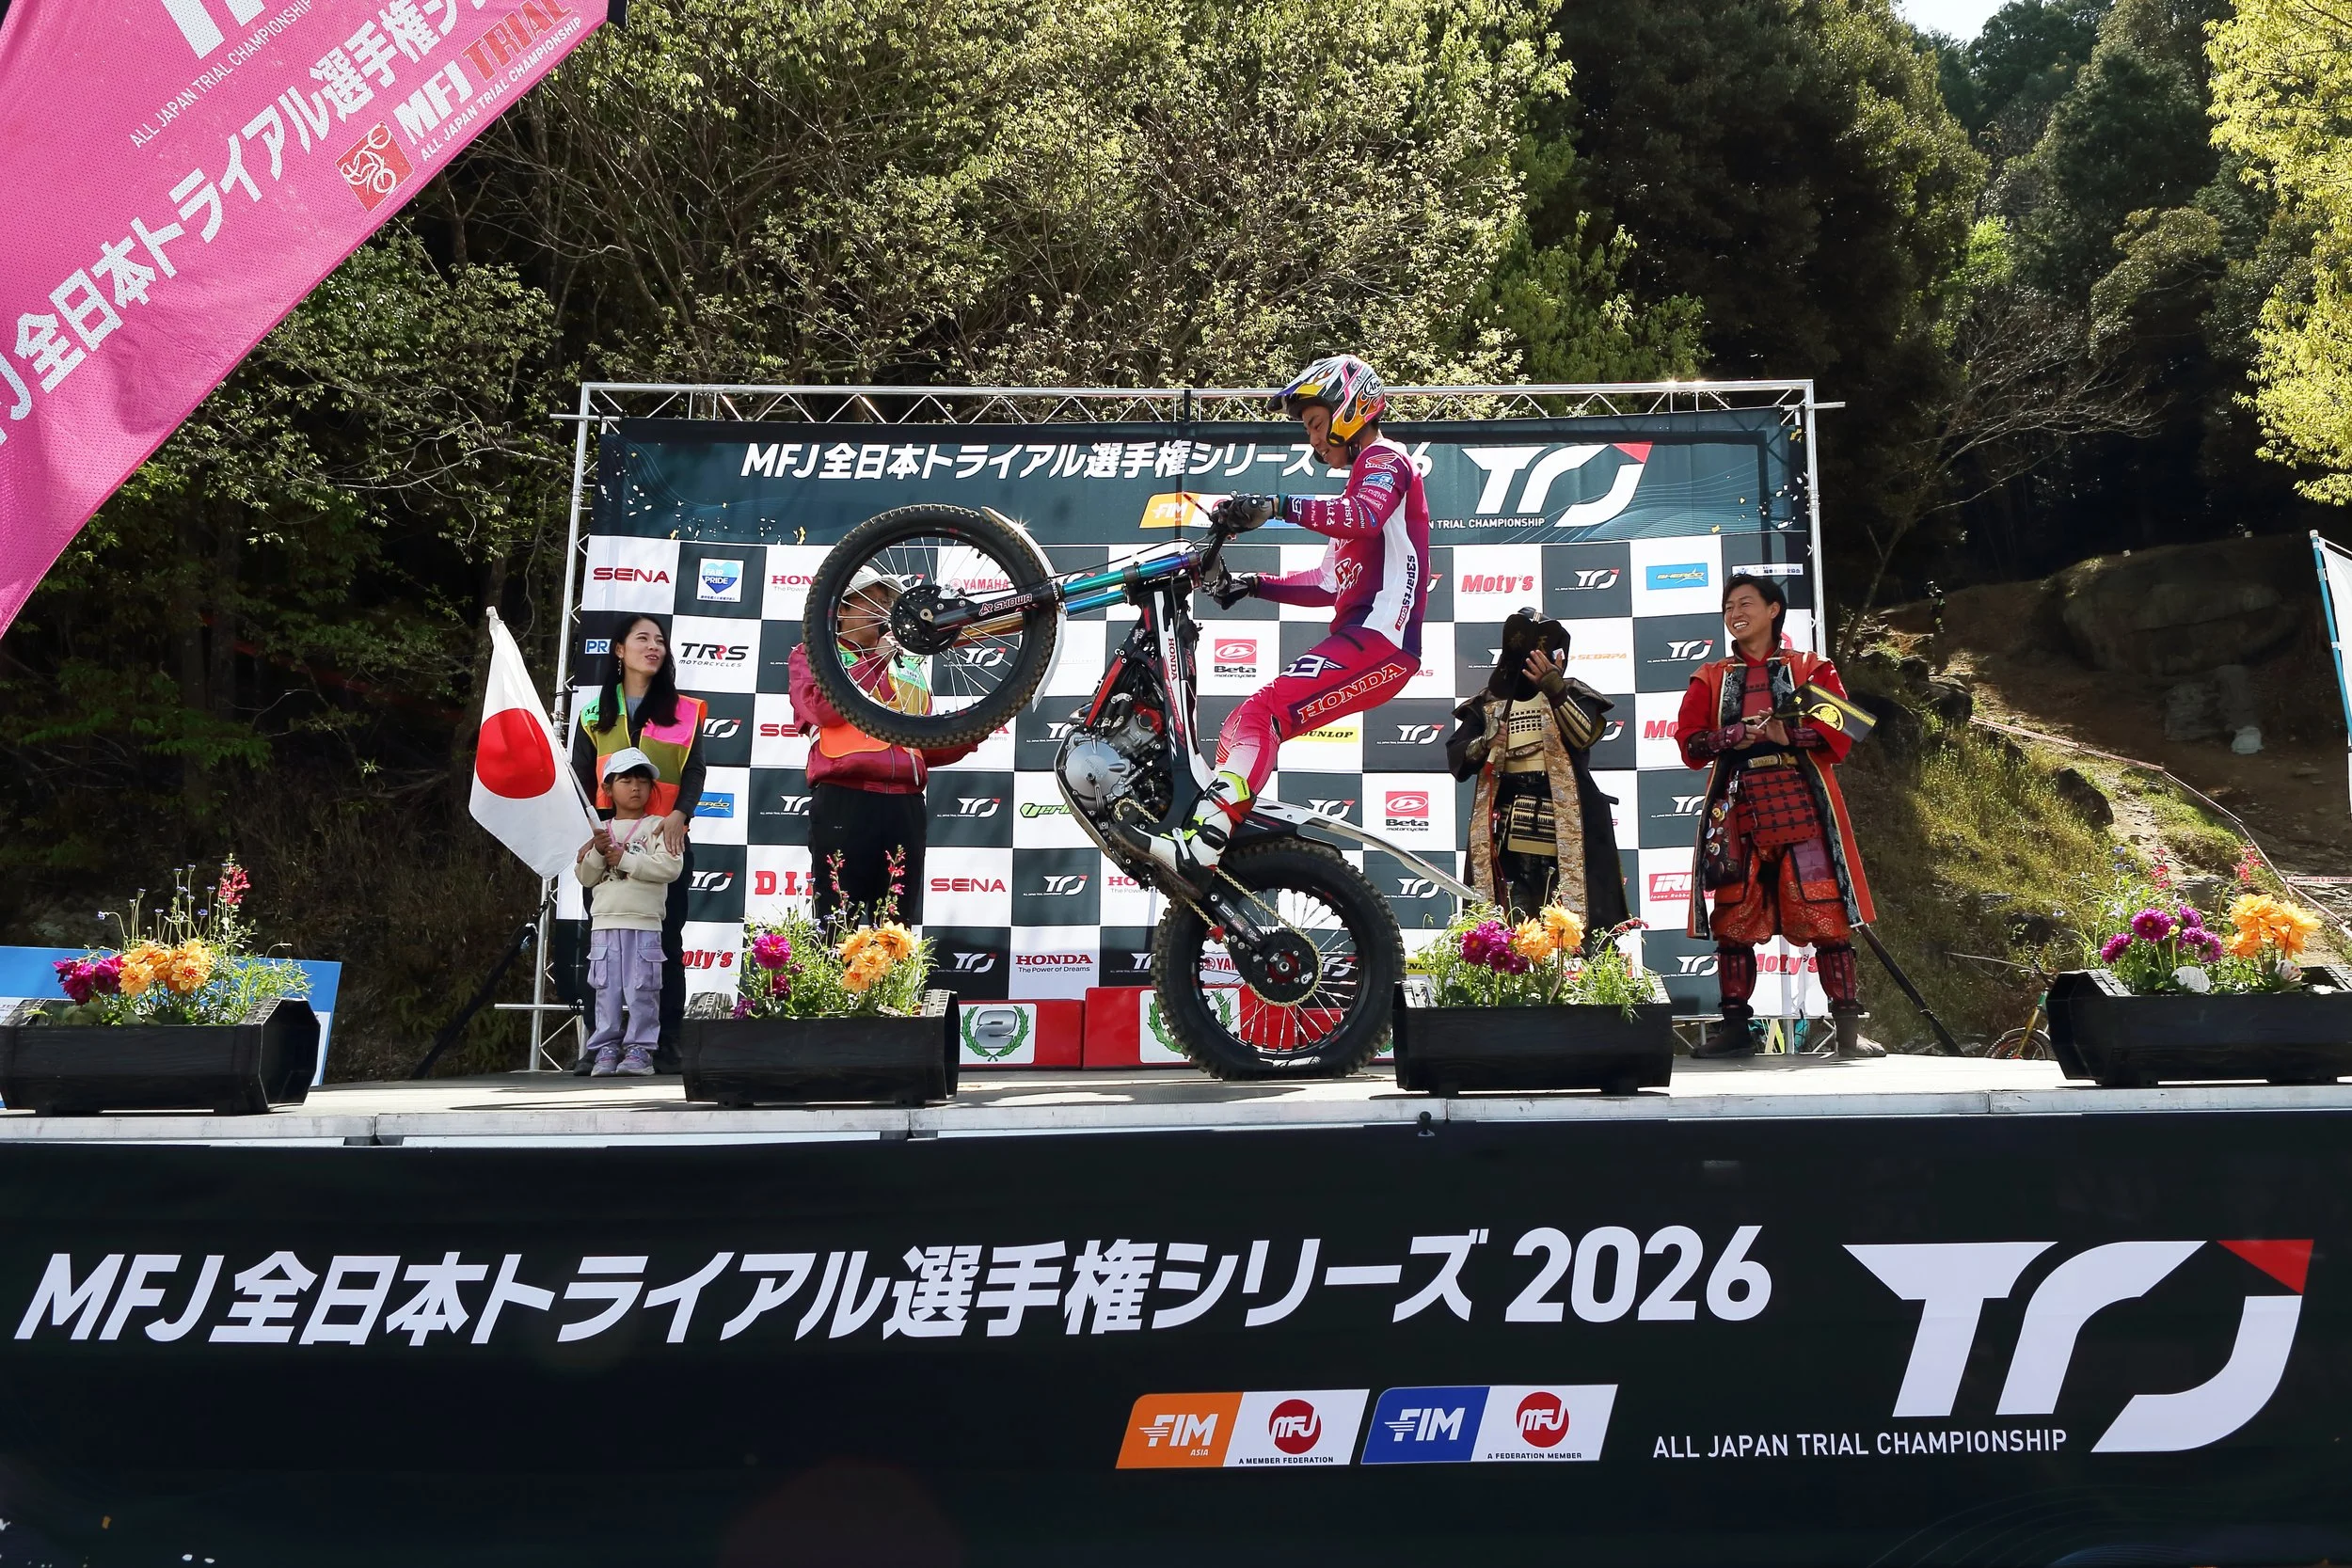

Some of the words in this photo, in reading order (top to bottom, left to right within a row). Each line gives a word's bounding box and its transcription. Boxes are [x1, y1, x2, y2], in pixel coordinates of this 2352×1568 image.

[393, 60, 474, 146] MFJ
[461, 0, 573, 83] TRIAL
[420, 138, 444, 162] ALL
[443, 104, 479, 142] JAPAN
[476, 79, 510, 109] TRIAL
[509, 17, 582, 83] CHAMPIONSHIP
[130, 123, 160, 149] ALL
[155, 87, 199, 127] JAPAN
[191, 62, 234, 93] TRIAL
[1437, 519, 1465, 529] TRIAL
[1469, 517, 1545, 528] CHAMPIONSHIP
[593, 567, 670, 584] SENA
[705, 576, 729, 585] PRIDE
[771, 575, 813, 584] HON
[963, 578, 1009, 591] YAMAHA
[1461, 574, 1534, 594] Moty's
[994, 594, 1033, 611] SHOWA
[586, 640, 610, 653] PR
[678, 659, 742, 668] MOTORCYCLES
[1168, 638, 1178, 681] HONDA
[1297, 662, 1407, 724] HONDA
[759, 723, 803, 737] SE
[1386, 818, 1428, 827] Beta
[930, 878, 1007, 893] SENA
[682, 949, 734, 970] oty's
[1015, 954, 1093, 965] HONDA
[976, 1010, 1017, 1048] 2
[1505, 1226, 1772, 1323] 2026
[1139, 1413, 1218, 1448] FIM
[1385, 1407, 1466, 1442] FIM
[1653, 1433, 1700, 1459] ALL
[1708, 1433, 1789, 1458] JAPAN
[1798, 1432, 1868, 1457] TRIAL
[1876, 1430, 2067, 1455] CHAMPIONSHIP
